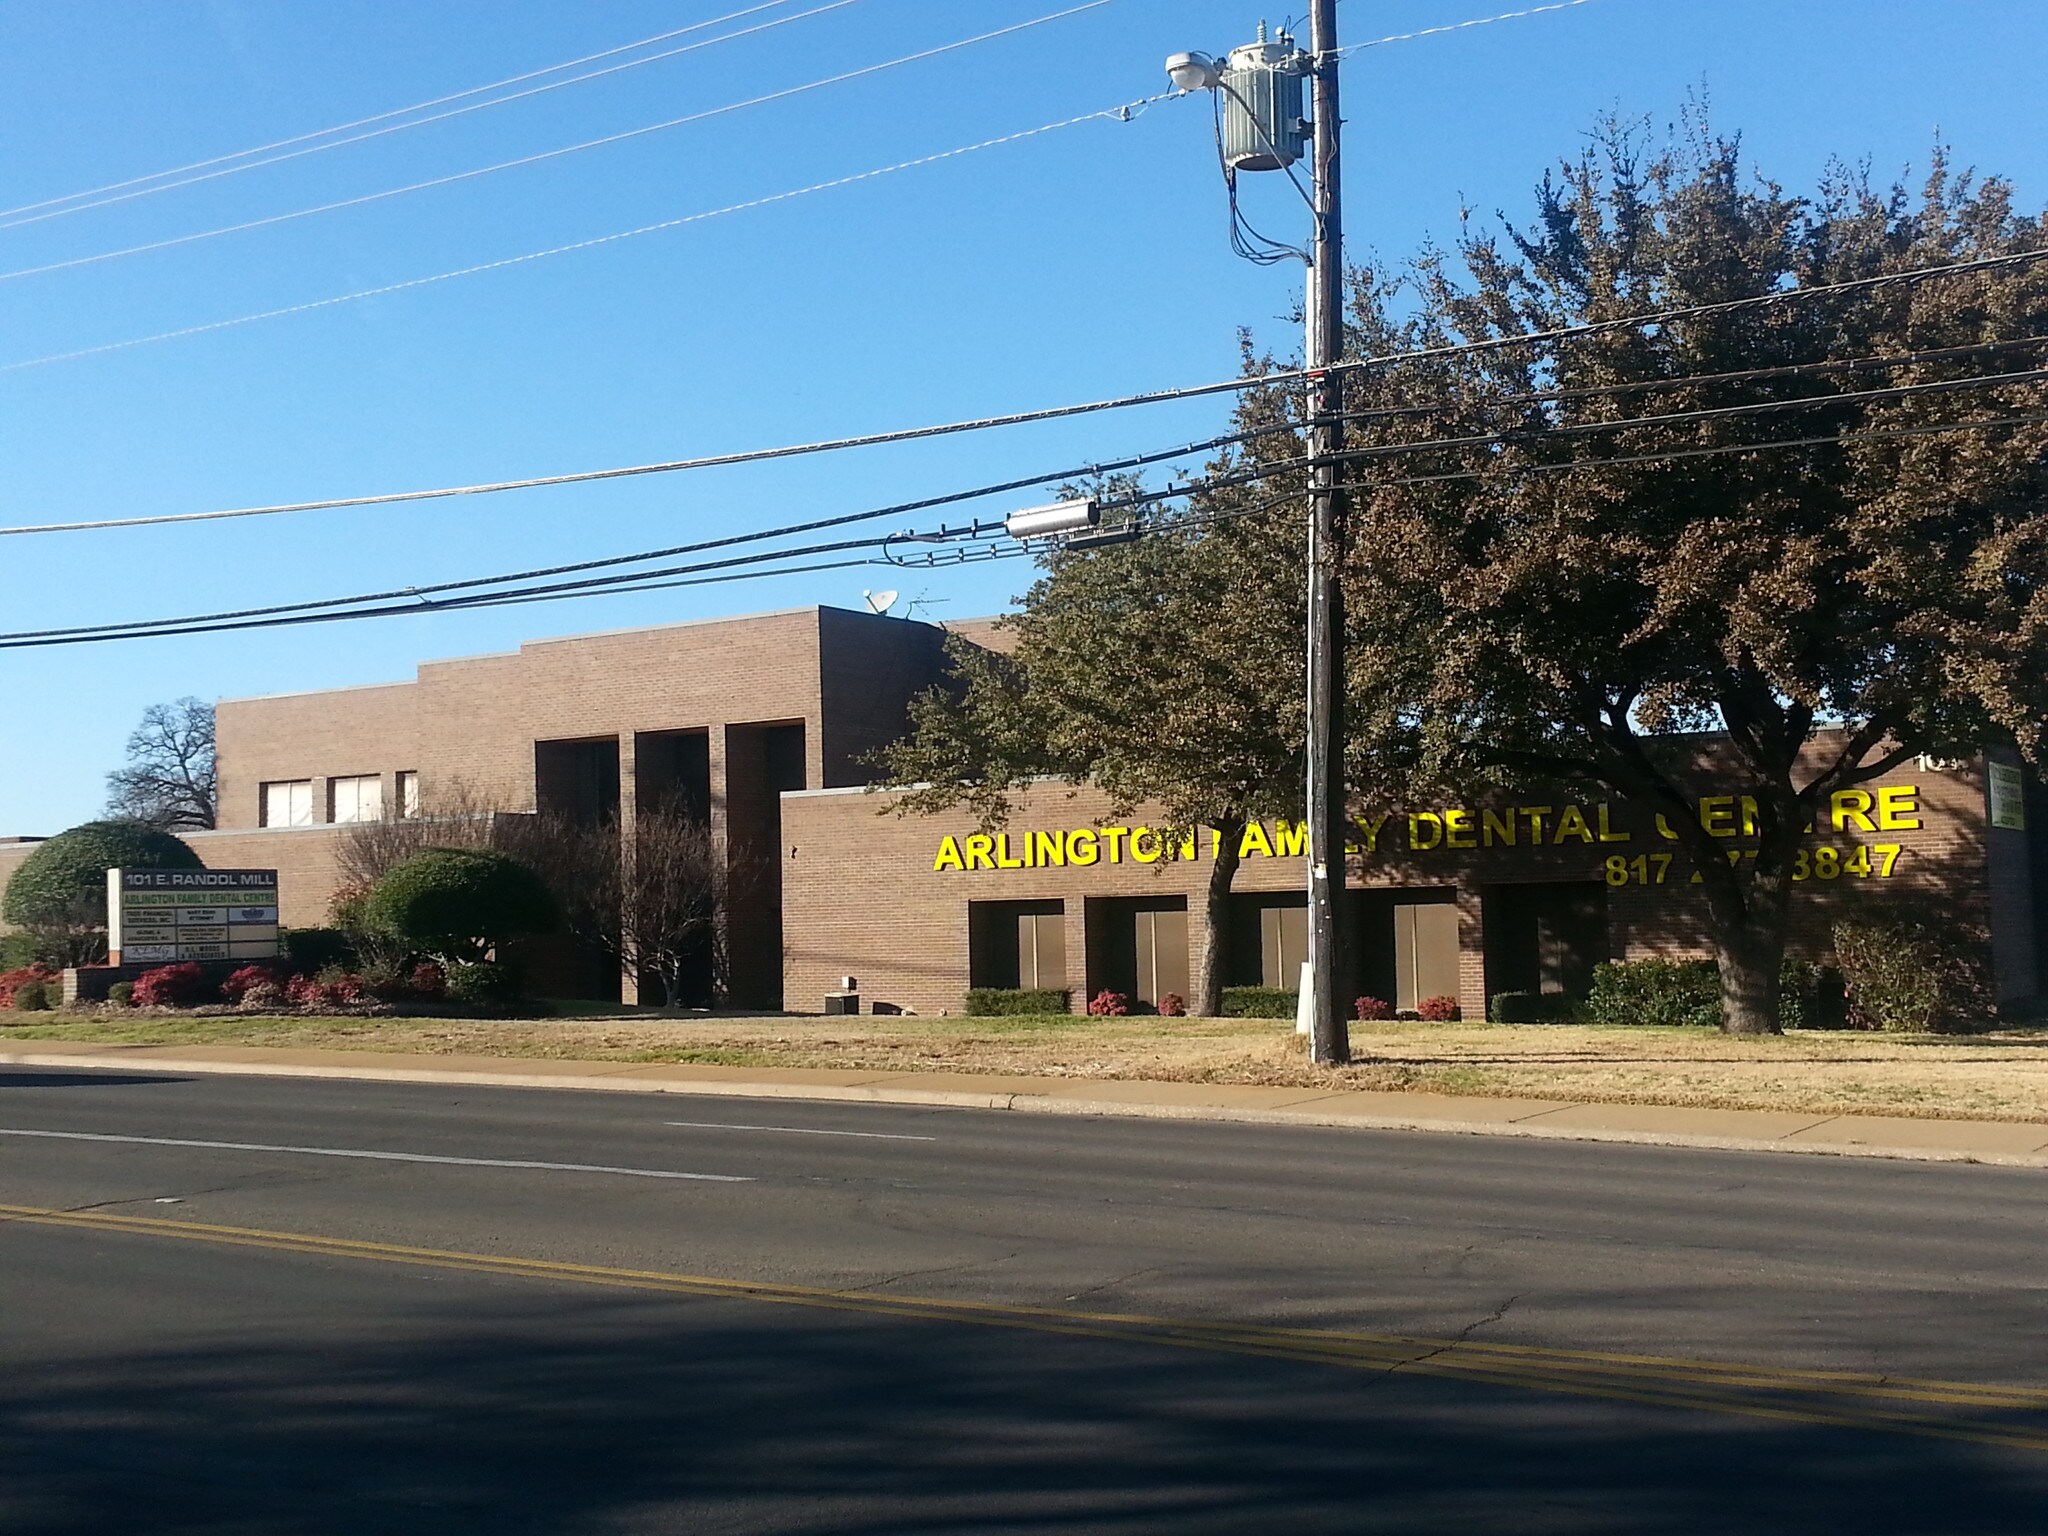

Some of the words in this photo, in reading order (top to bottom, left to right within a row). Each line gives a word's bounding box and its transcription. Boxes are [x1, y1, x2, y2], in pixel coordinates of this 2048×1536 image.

[933, 826, 1195, 870] ARLINGTON
[1212, 816, 1390, 859] AMY
[1409, 803, 1631, 850] DENTAL
[1605, 853, 1673, 887] 817
[1792, 844, 1901, 882] 3847
[126, 874, 150, 886] 101
[156, 874, 169, 886] E.
[172, 874, 237, 885] RANDOL
[241, 874, 274, 885] MILL
[125, 893, 175, 905] ARLINGTON
[177, 893, 207, 904] FAMILY
[209, 893, 241, 904] DENTAL
[243, 893, 275, 903] CENTRE
